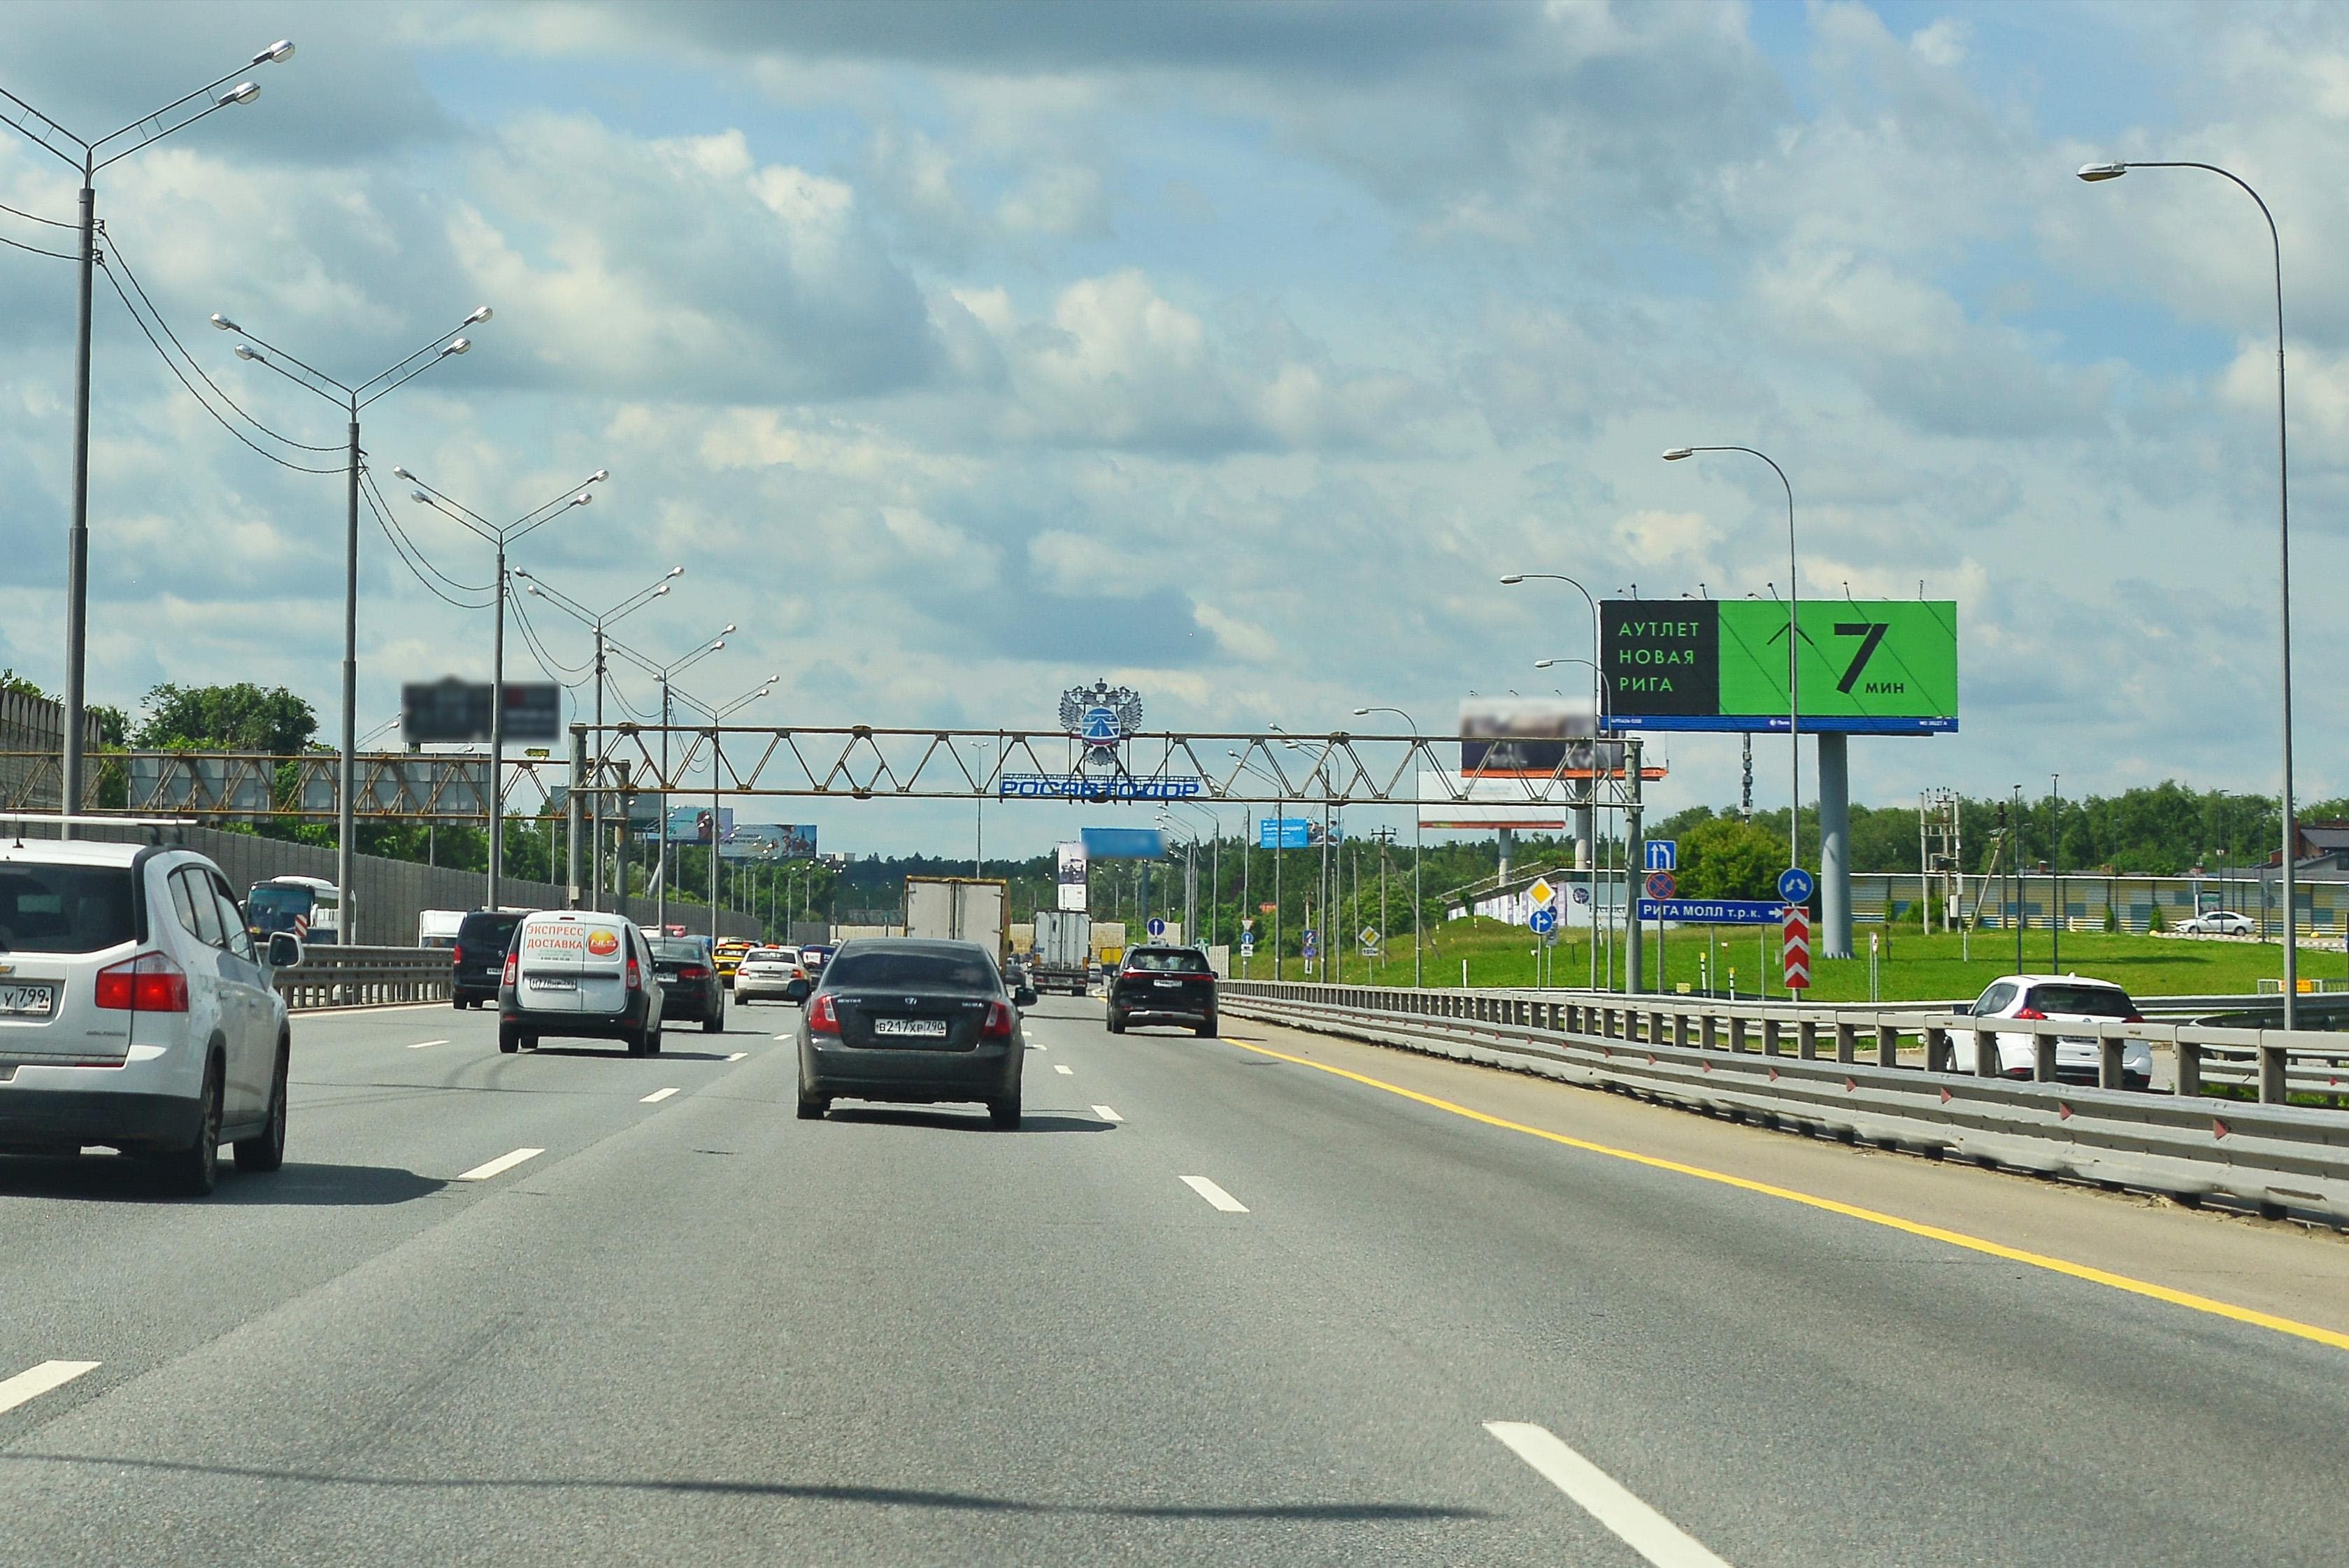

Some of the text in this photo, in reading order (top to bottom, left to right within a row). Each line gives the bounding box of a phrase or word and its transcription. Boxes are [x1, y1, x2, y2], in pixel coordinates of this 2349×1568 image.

[1618, 621, 1699, 636] АУТЛЕТ
[1619, 649, 1694, 664] НОВАЯ
[1834, 622, 1890, 694] 7
[1619, 676, 1673, 692] РИГА
[1001, 781, 1199, 797] РОСАВТОДОР
[1643, 904, 1761, 920] РИГА МОЛЛ т.р.к.
[527, 925, 584, 936] ЭКСПРЕСС
[527, 939, 583, 949] ДОСТАВКА
[19, 988, 47, 1003] 799
